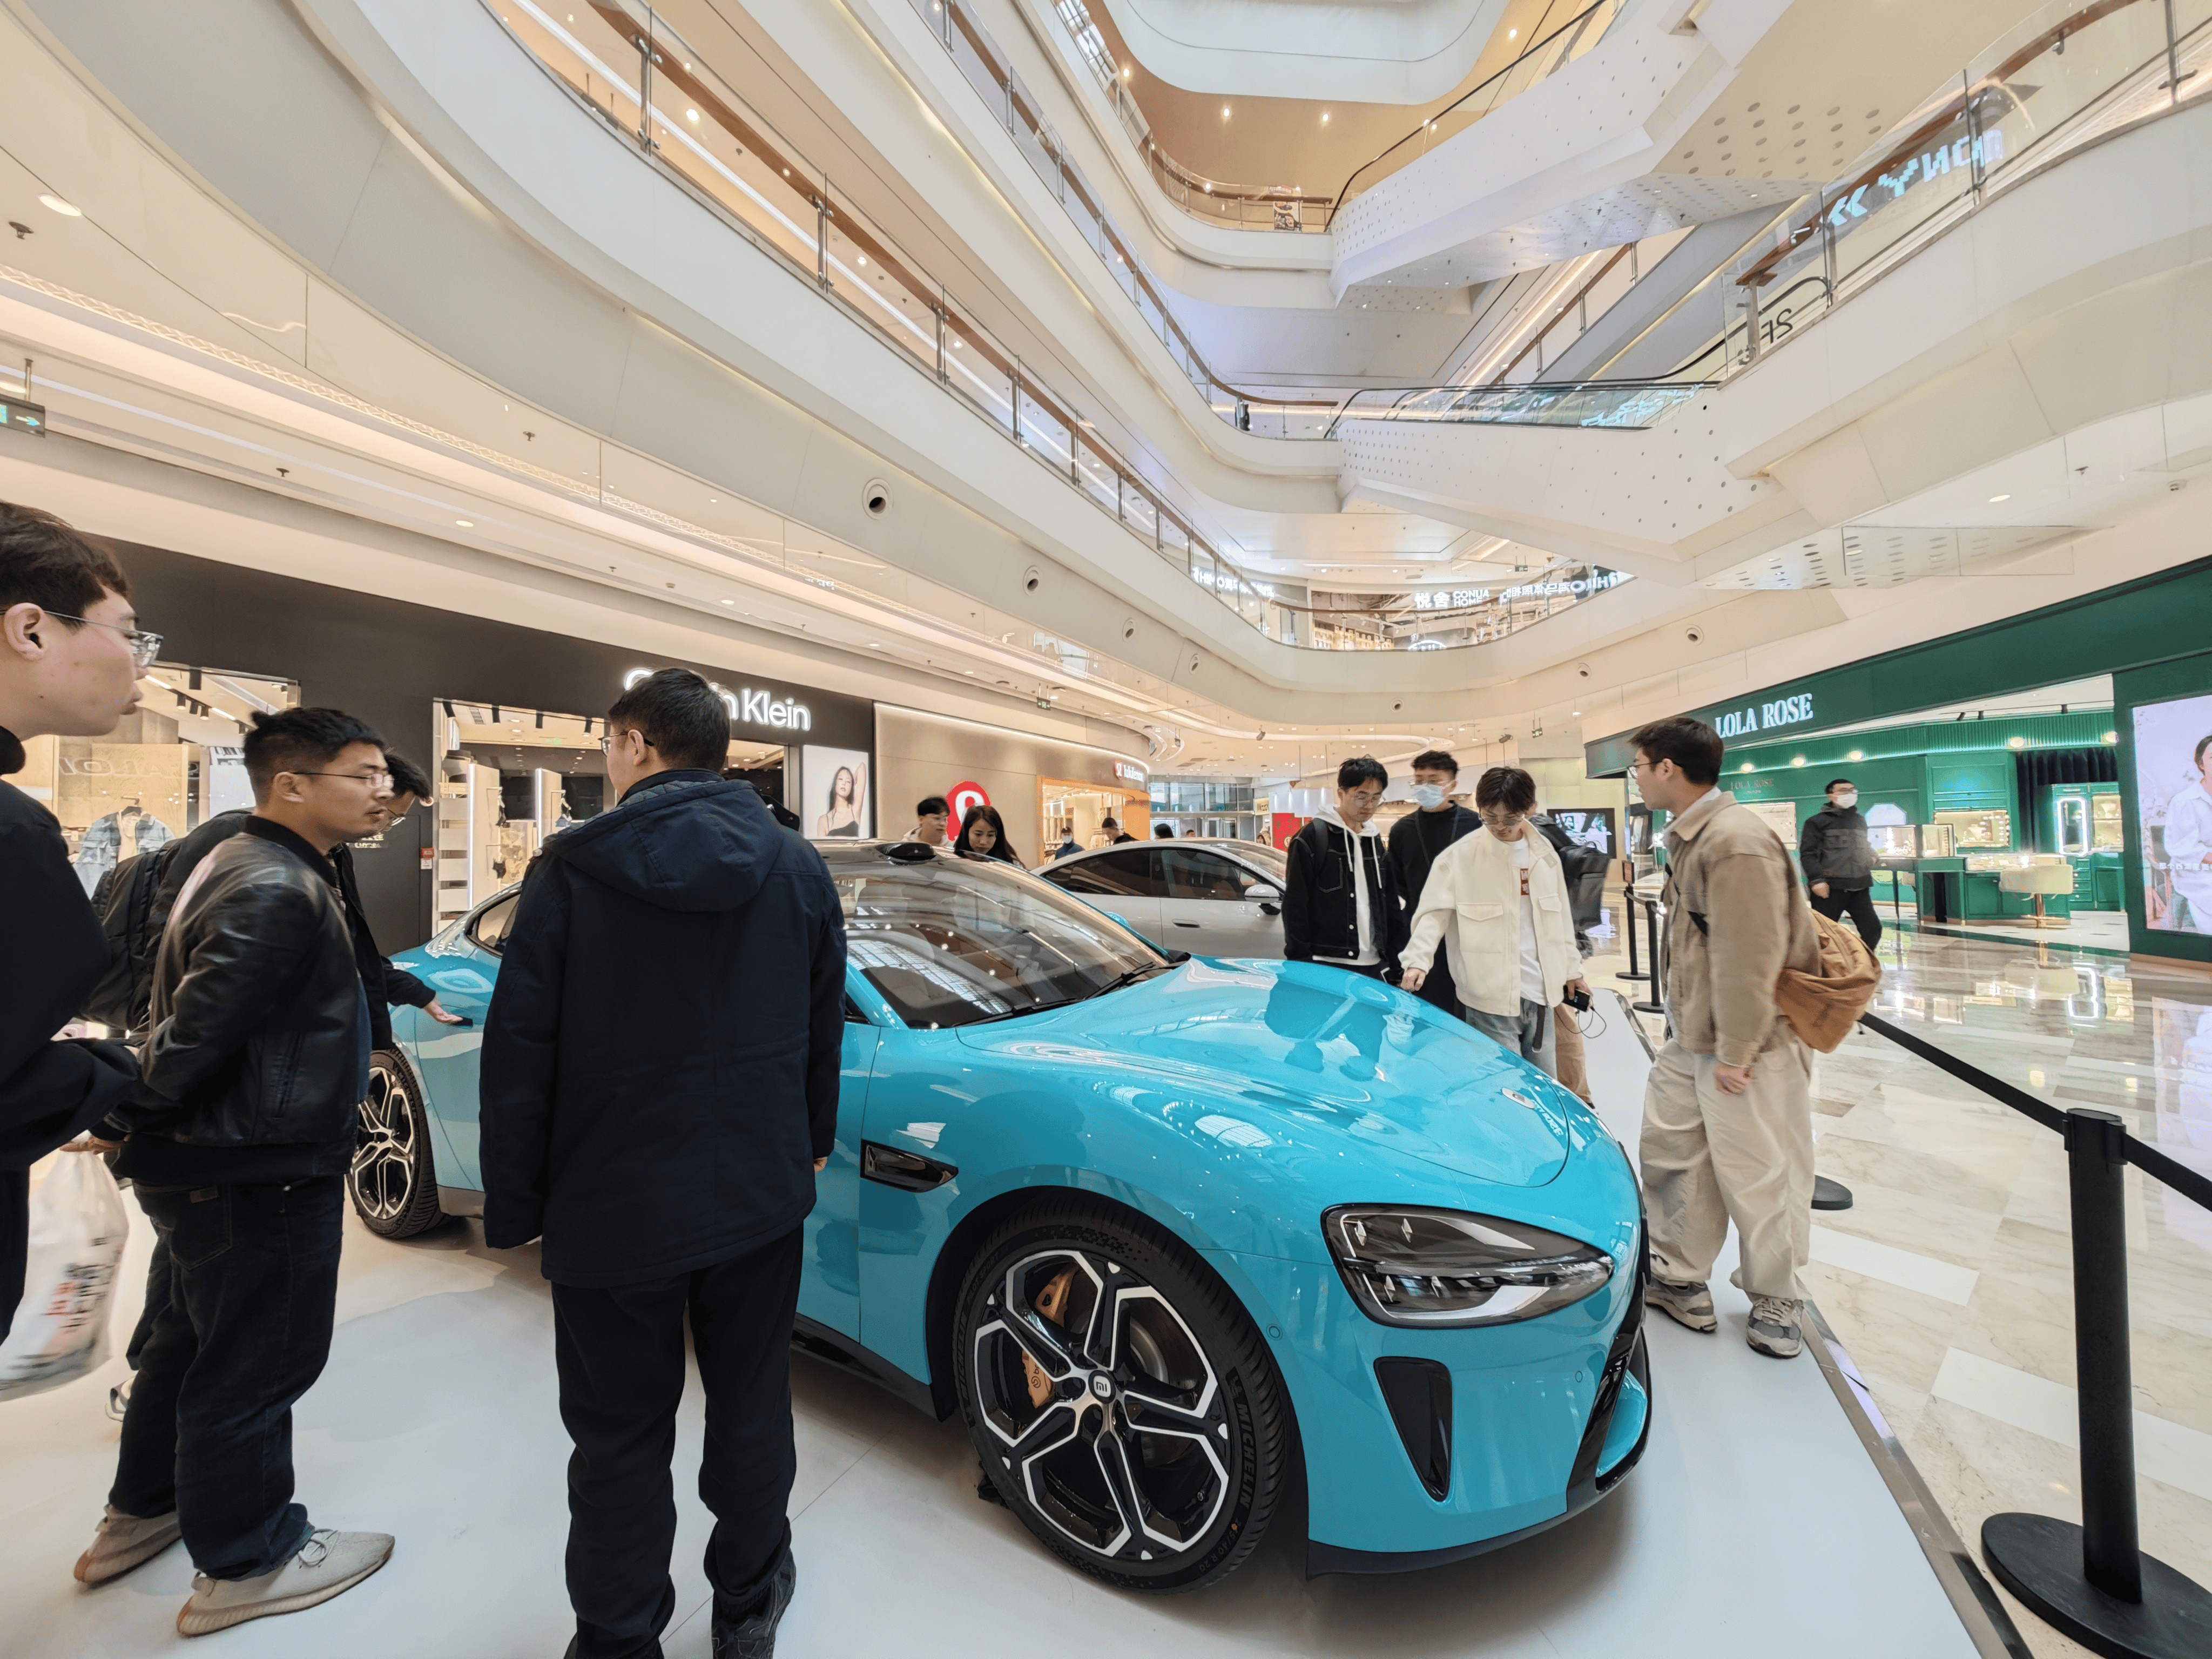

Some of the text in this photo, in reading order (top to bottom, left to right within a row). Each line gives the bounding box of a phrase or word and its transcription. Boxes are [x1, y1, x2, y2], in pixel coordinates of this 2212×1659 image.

[1415, 592, 1450, 609] 悦舍
[743, 690, 810, 730] Klein
[1715, 693, 1813, 738] LOLA ROSE
[1236, 1402, 1256, 1509] MICHELIN
[1218, 1517, 1242, 1555] 25/40
